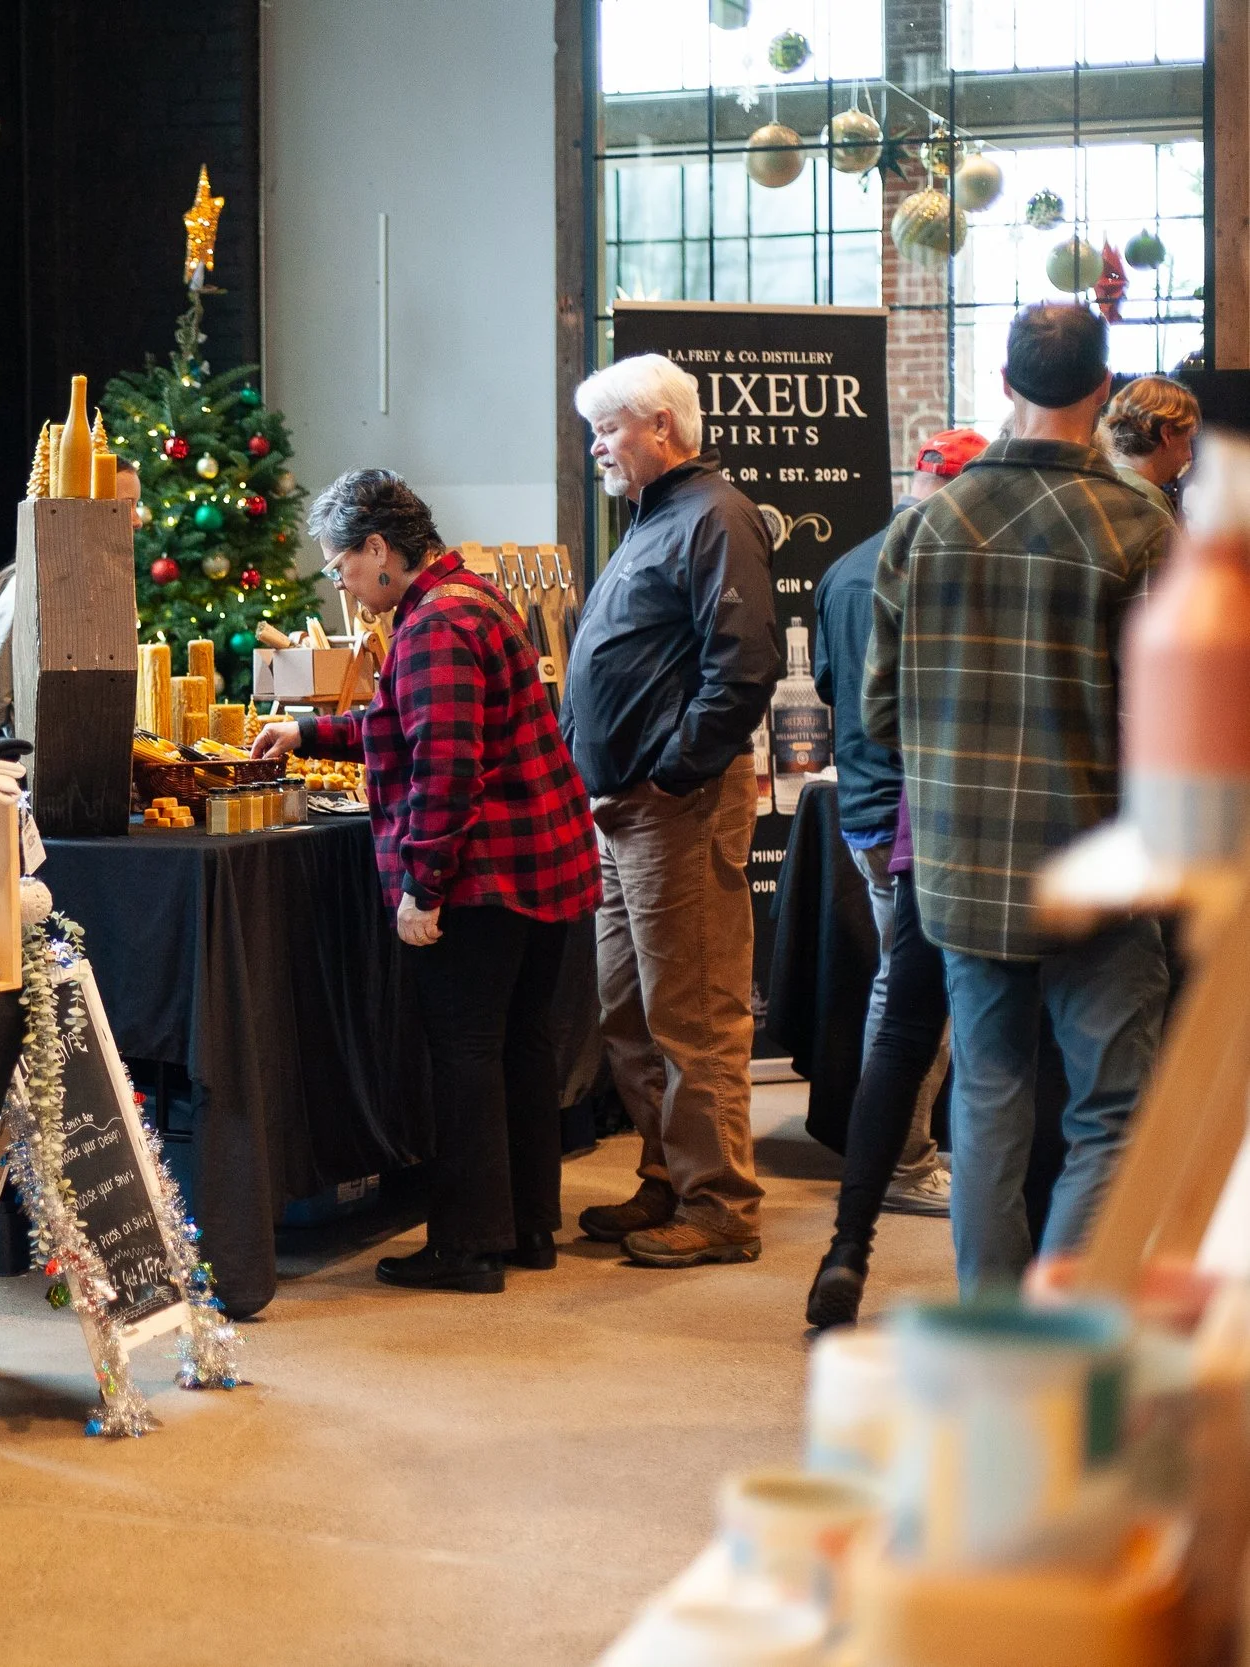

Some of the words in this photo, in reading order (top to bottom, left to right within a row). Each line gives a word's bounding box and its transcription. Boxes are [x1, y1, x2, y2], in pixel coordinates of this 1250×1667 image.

[724, 350, 735, 363] &
[738, 350, 760, 363] CO.
[762, 351, 834, 364] DISTILLERY
[703, 425, 820, 446] PIRITS
[719, 467, 735, 482] G,
[739, 467, 758, 482] OR
[779, 467, 809, 482] EST.
[814, 468, 848, 482] 2020
[776, 578, 800, 593] GIN
[752, 880, 777, 893] OUR
[60, 1147, 81, 1166] hoose
[74, 1190, 98, 1211] hoose
[97, 1179, 113, 1201] your
[123, 1222, 132, 1235] on
